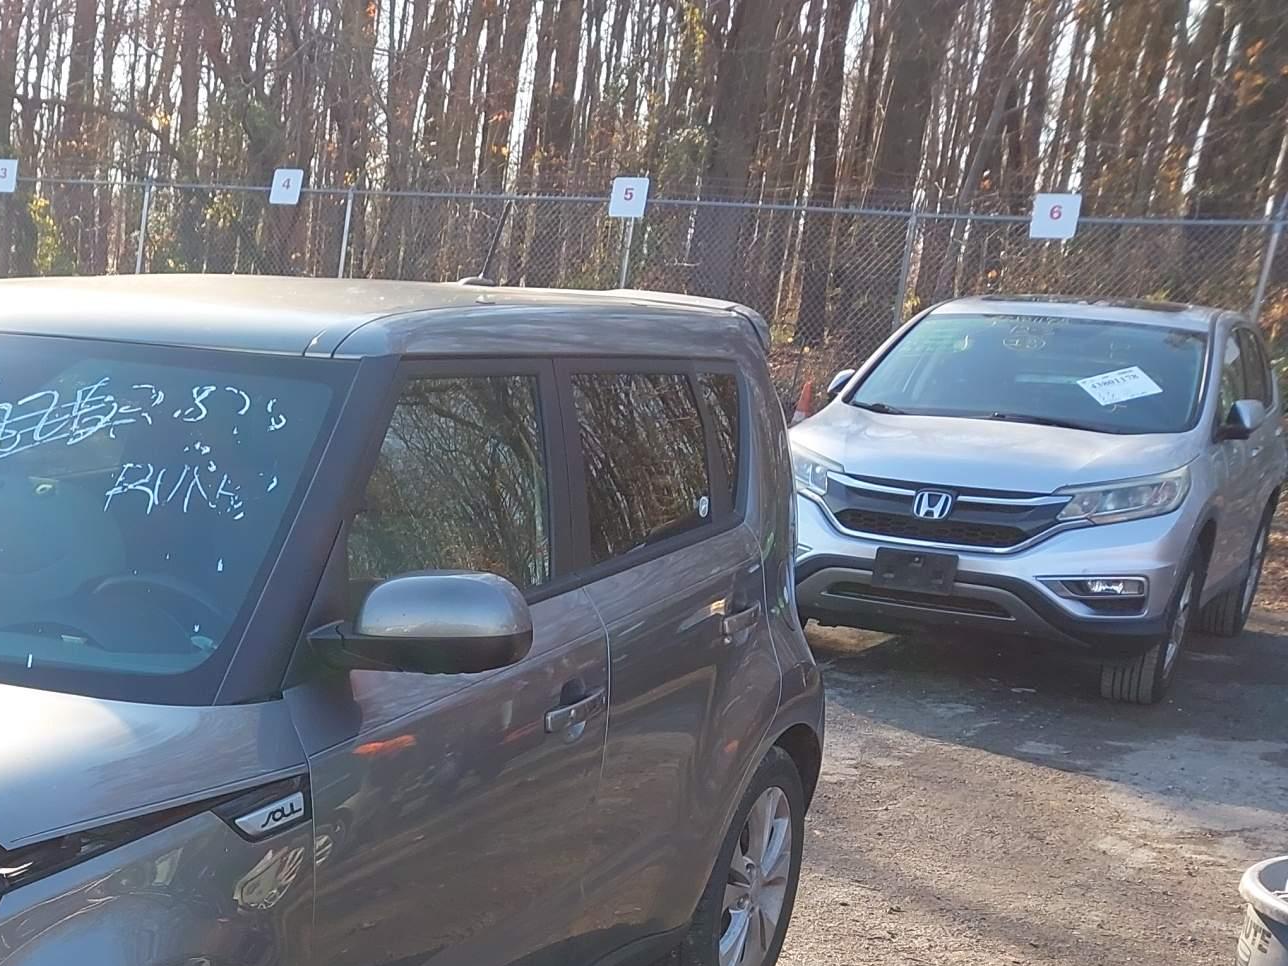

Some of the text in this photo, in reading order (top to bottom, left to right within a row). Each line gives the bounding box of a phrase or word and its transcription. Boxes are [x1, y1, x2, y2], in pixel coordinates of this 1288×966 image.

[0, 167, 8, 179] 3
[281, 177, 291, 190] 4
[623, 187, 635, 201] 5
[1049, 204, 1063, 220] 6
[261, 802, 302, 828] SOUL
